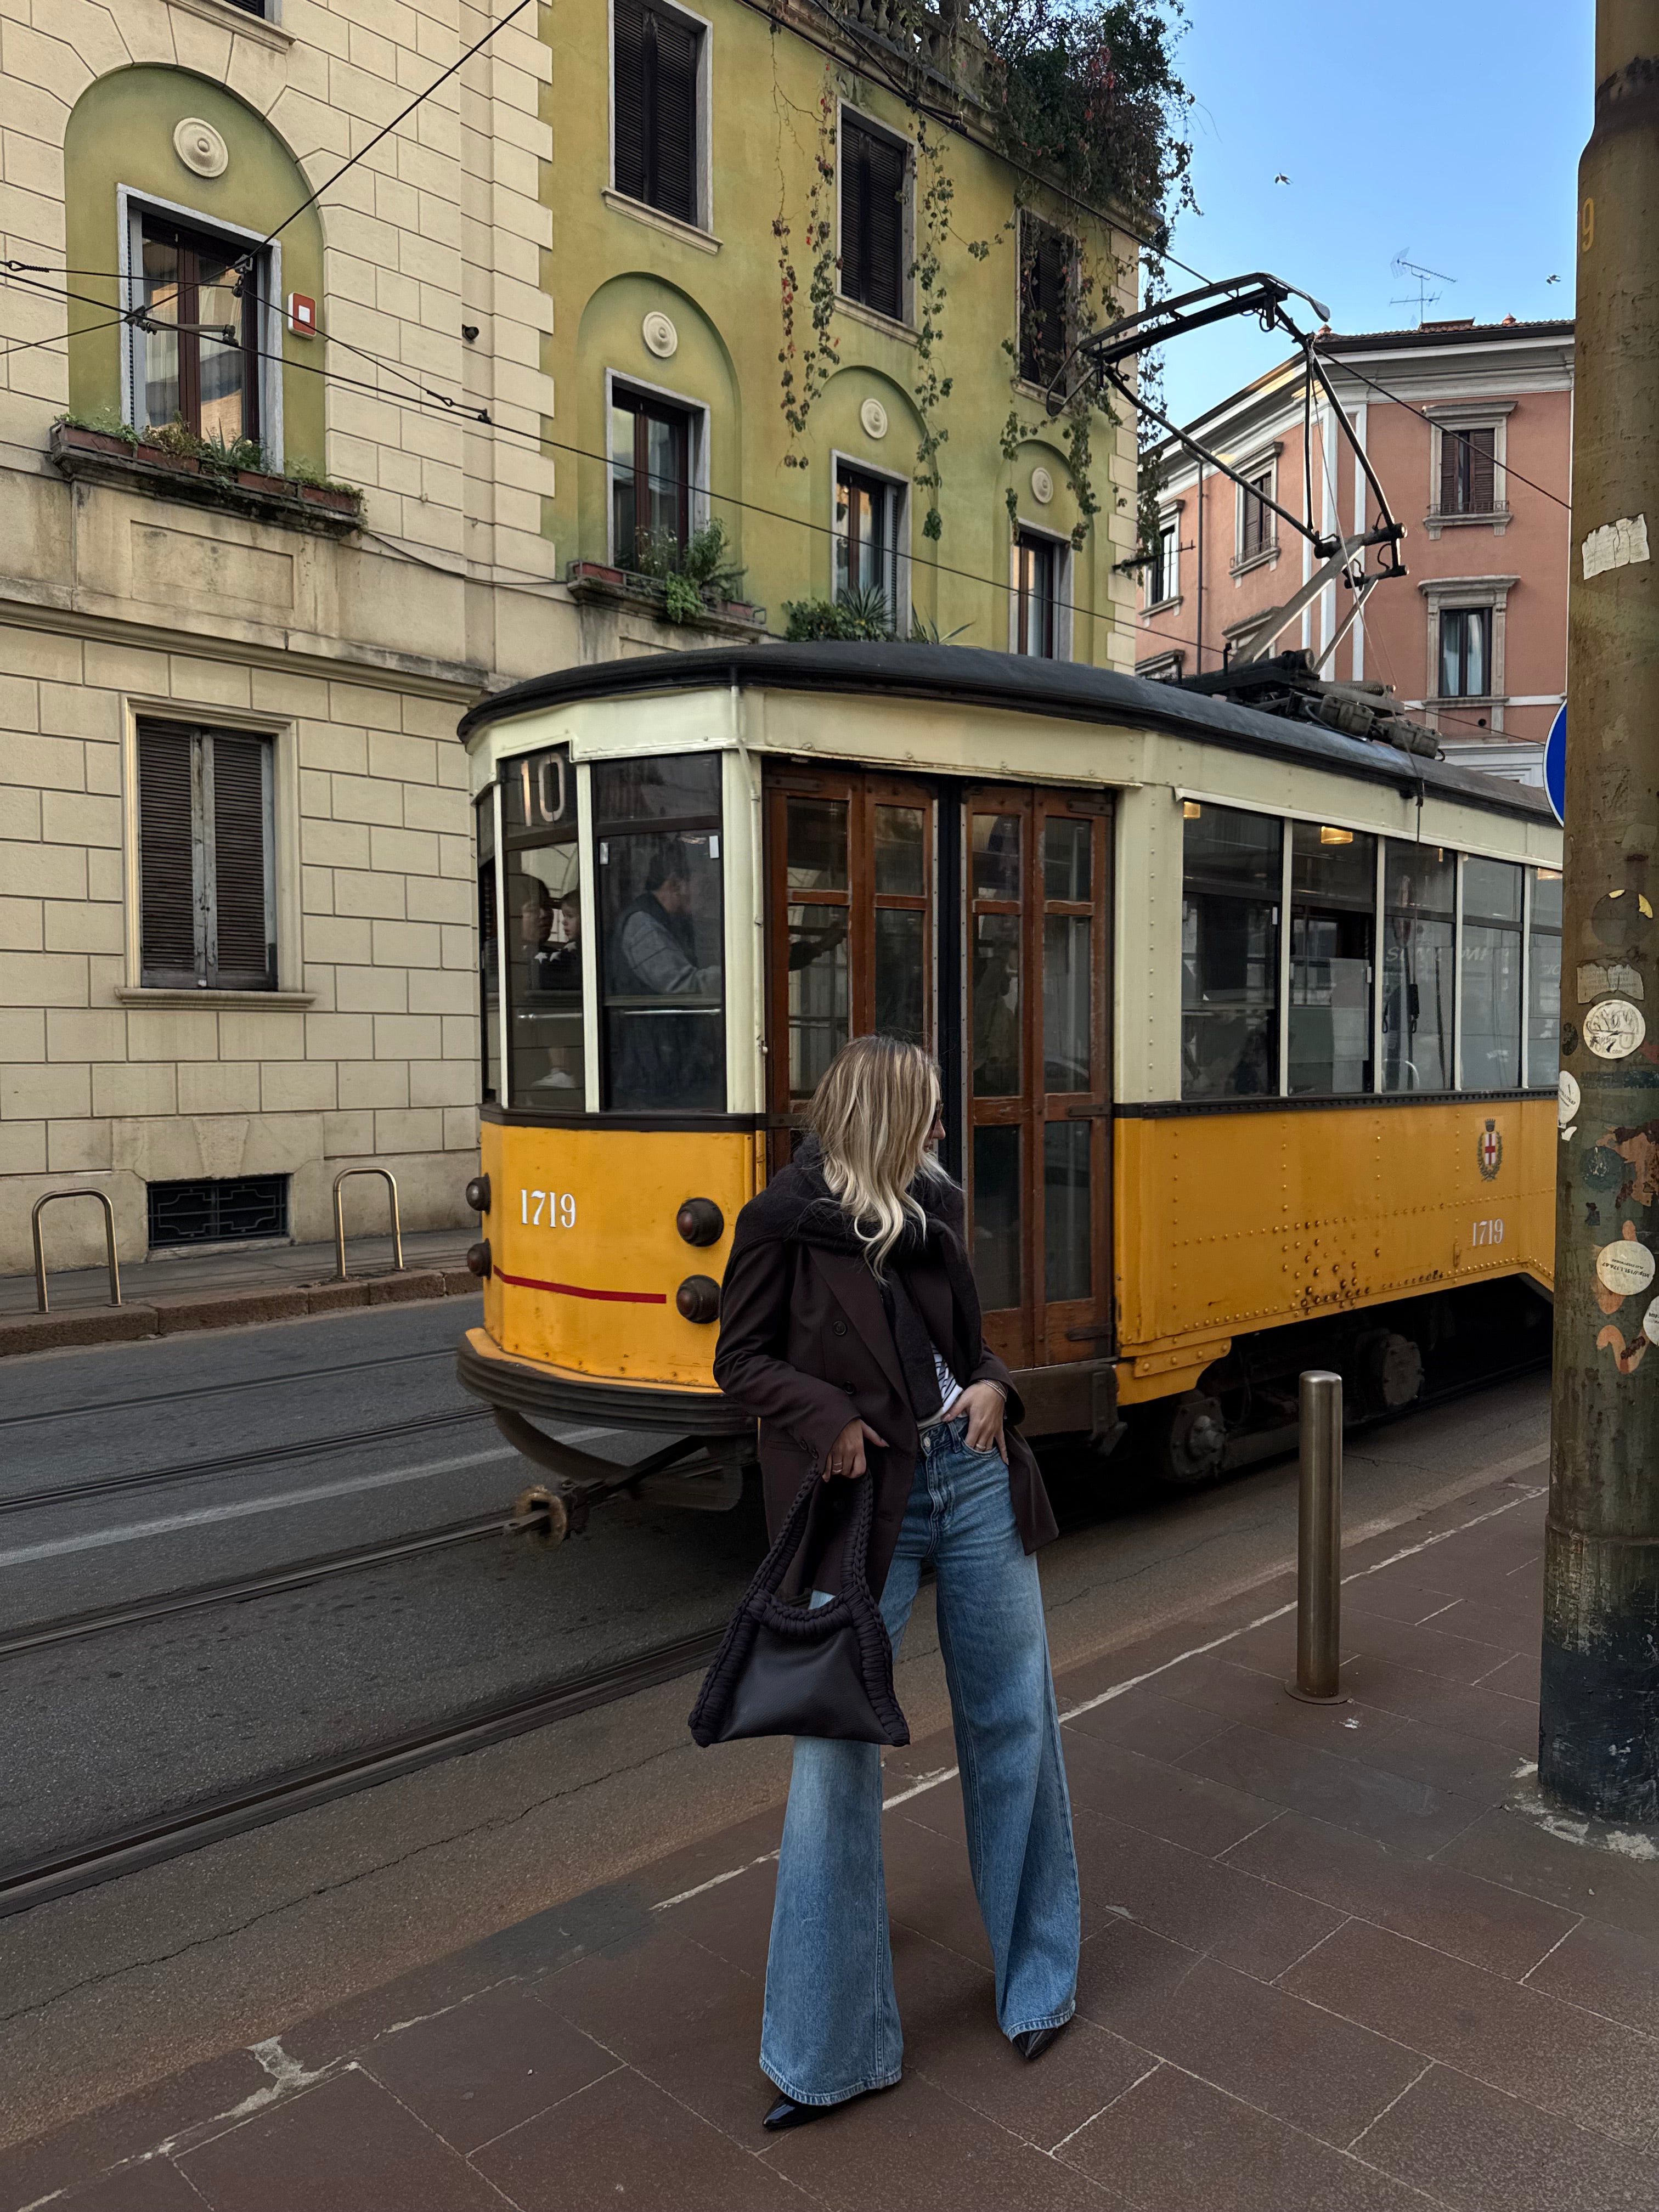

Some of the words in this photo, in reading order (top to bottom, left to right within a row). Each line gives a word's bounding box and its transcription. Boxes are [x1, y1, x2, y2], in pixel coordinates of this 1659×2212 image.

[521, 753, 565, 826] 10
[521, 1188, 575, 1228] 1719
[1472, 1218, 1504, 1246] 1719
